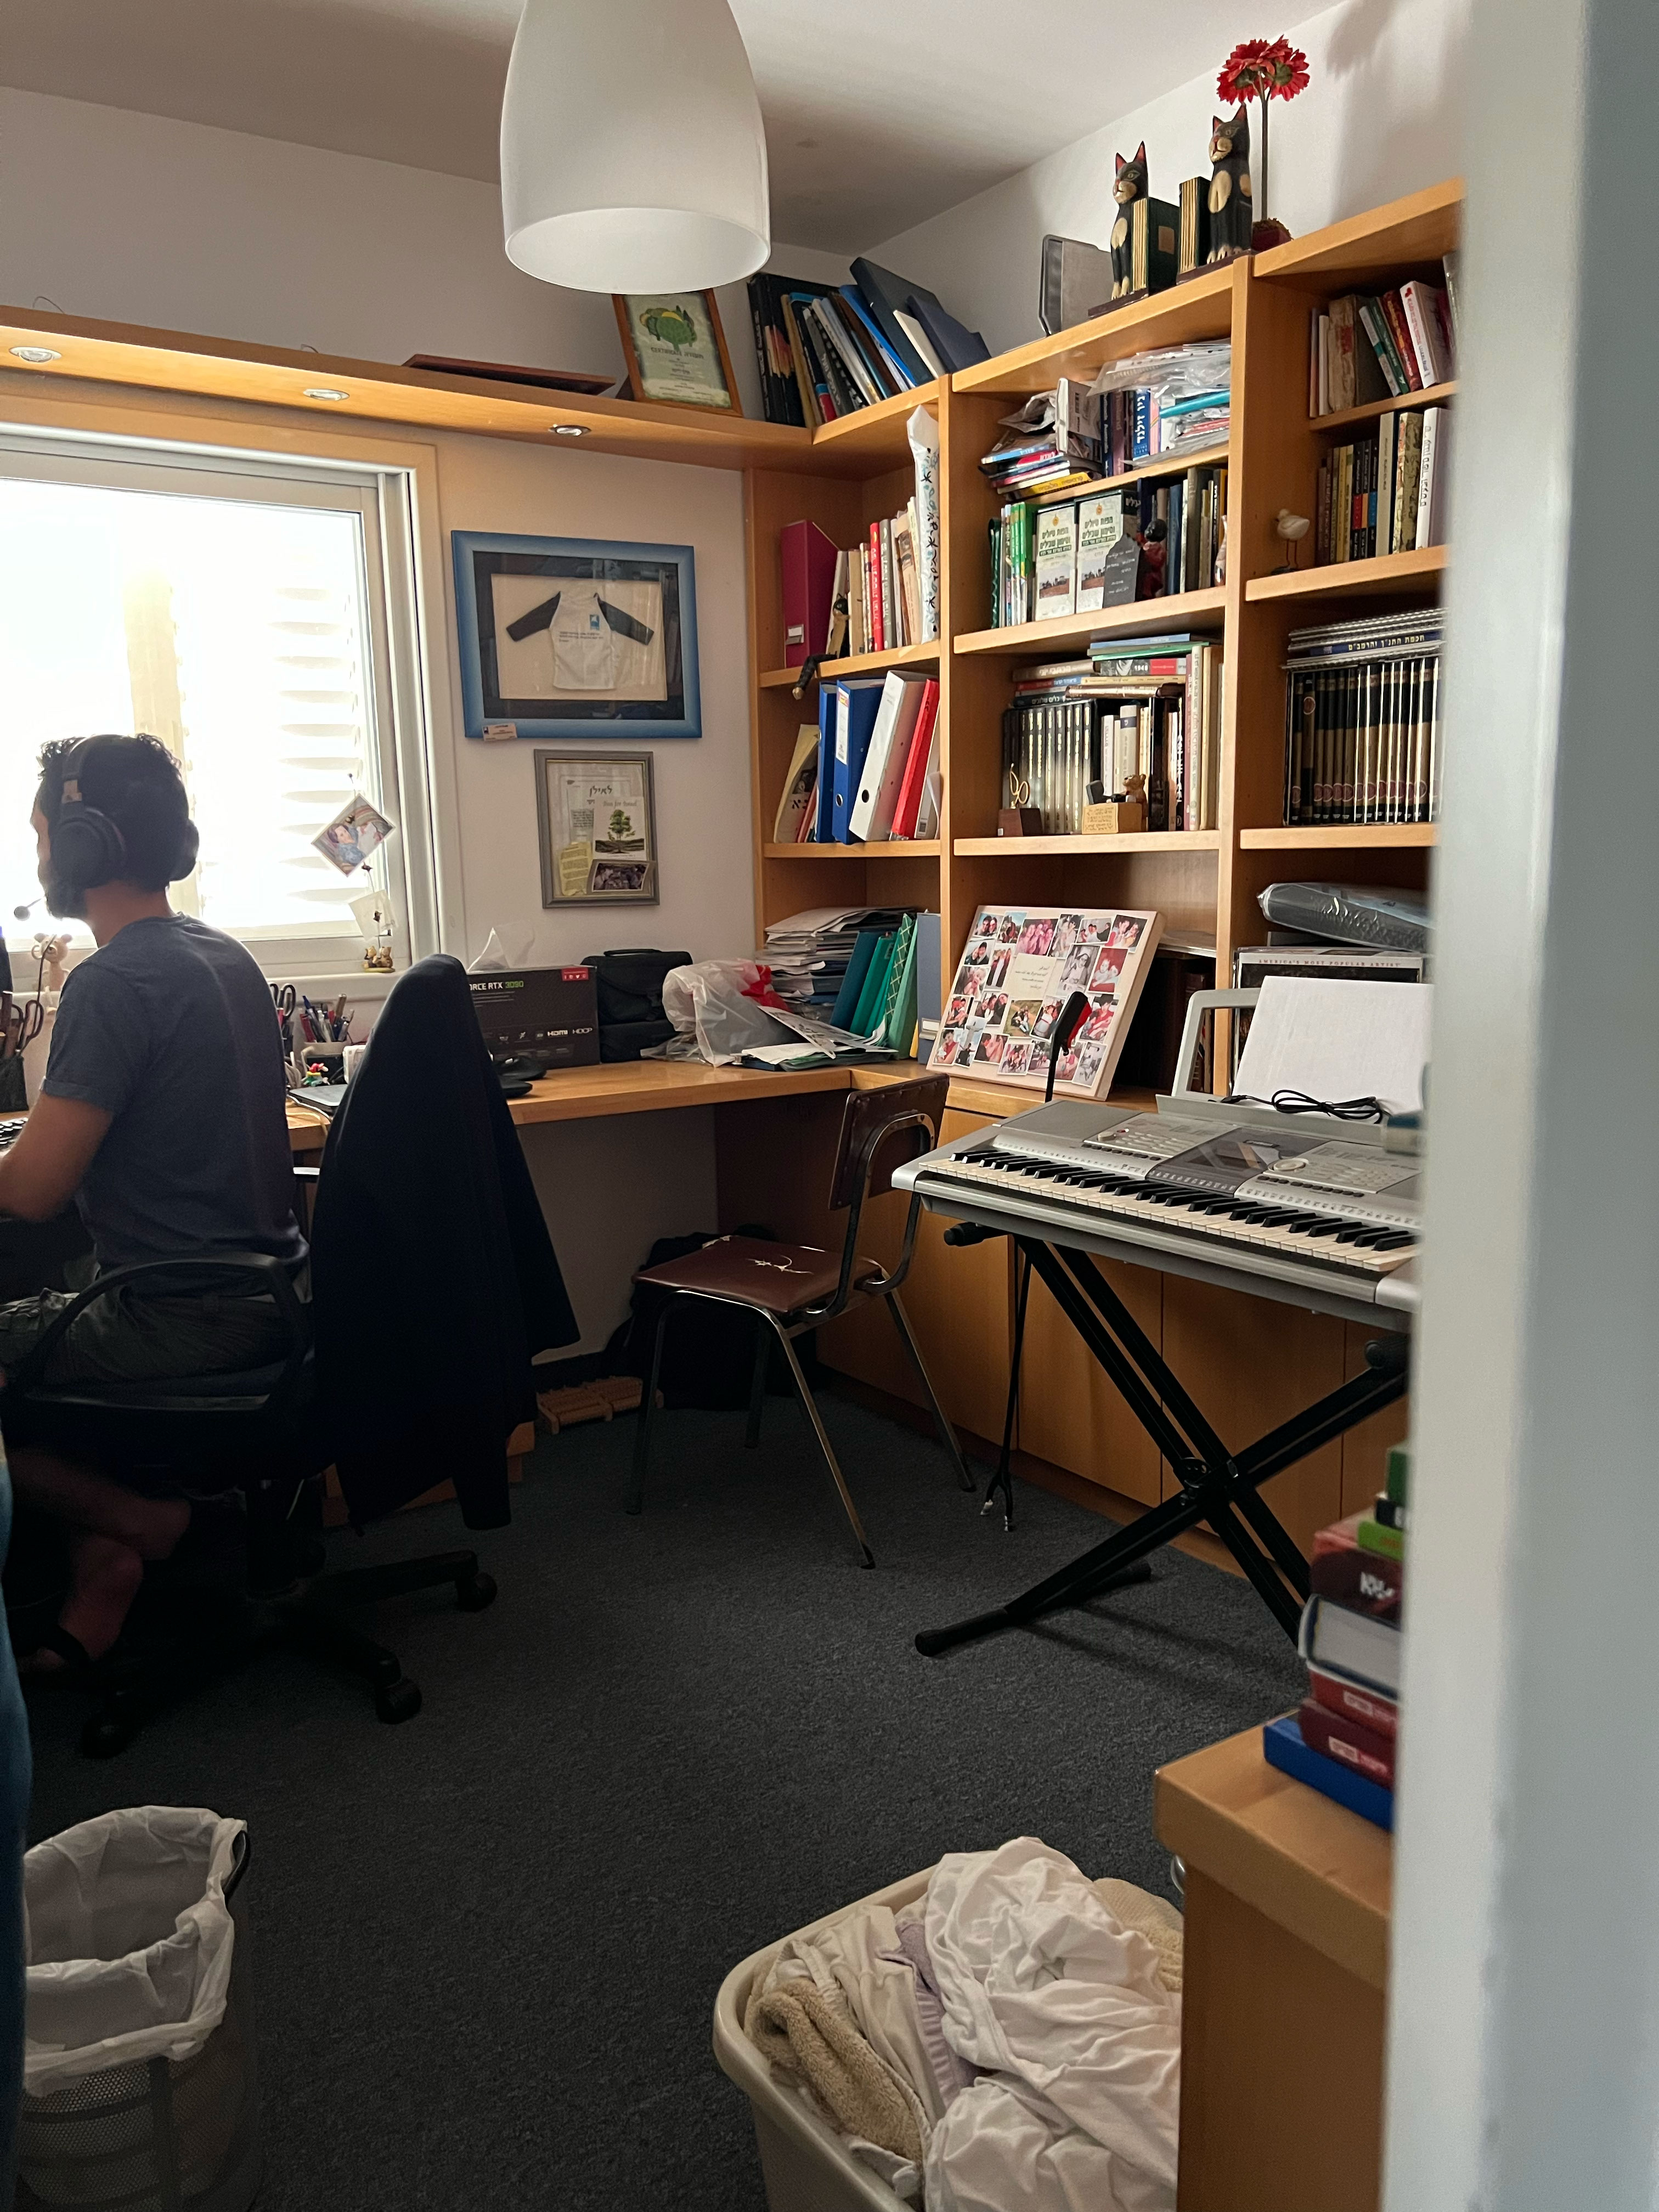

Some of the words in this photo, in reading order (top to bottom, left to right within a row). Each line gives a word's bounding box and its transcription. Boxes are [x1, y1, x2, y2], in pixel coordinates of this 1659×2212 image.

[1137, 396, 1146, 411] ניו
[1135, 415, 1146, 444] זילנד
[589, 785, 613, 797] לאילן
[488, 981, 503, 990] RTX
